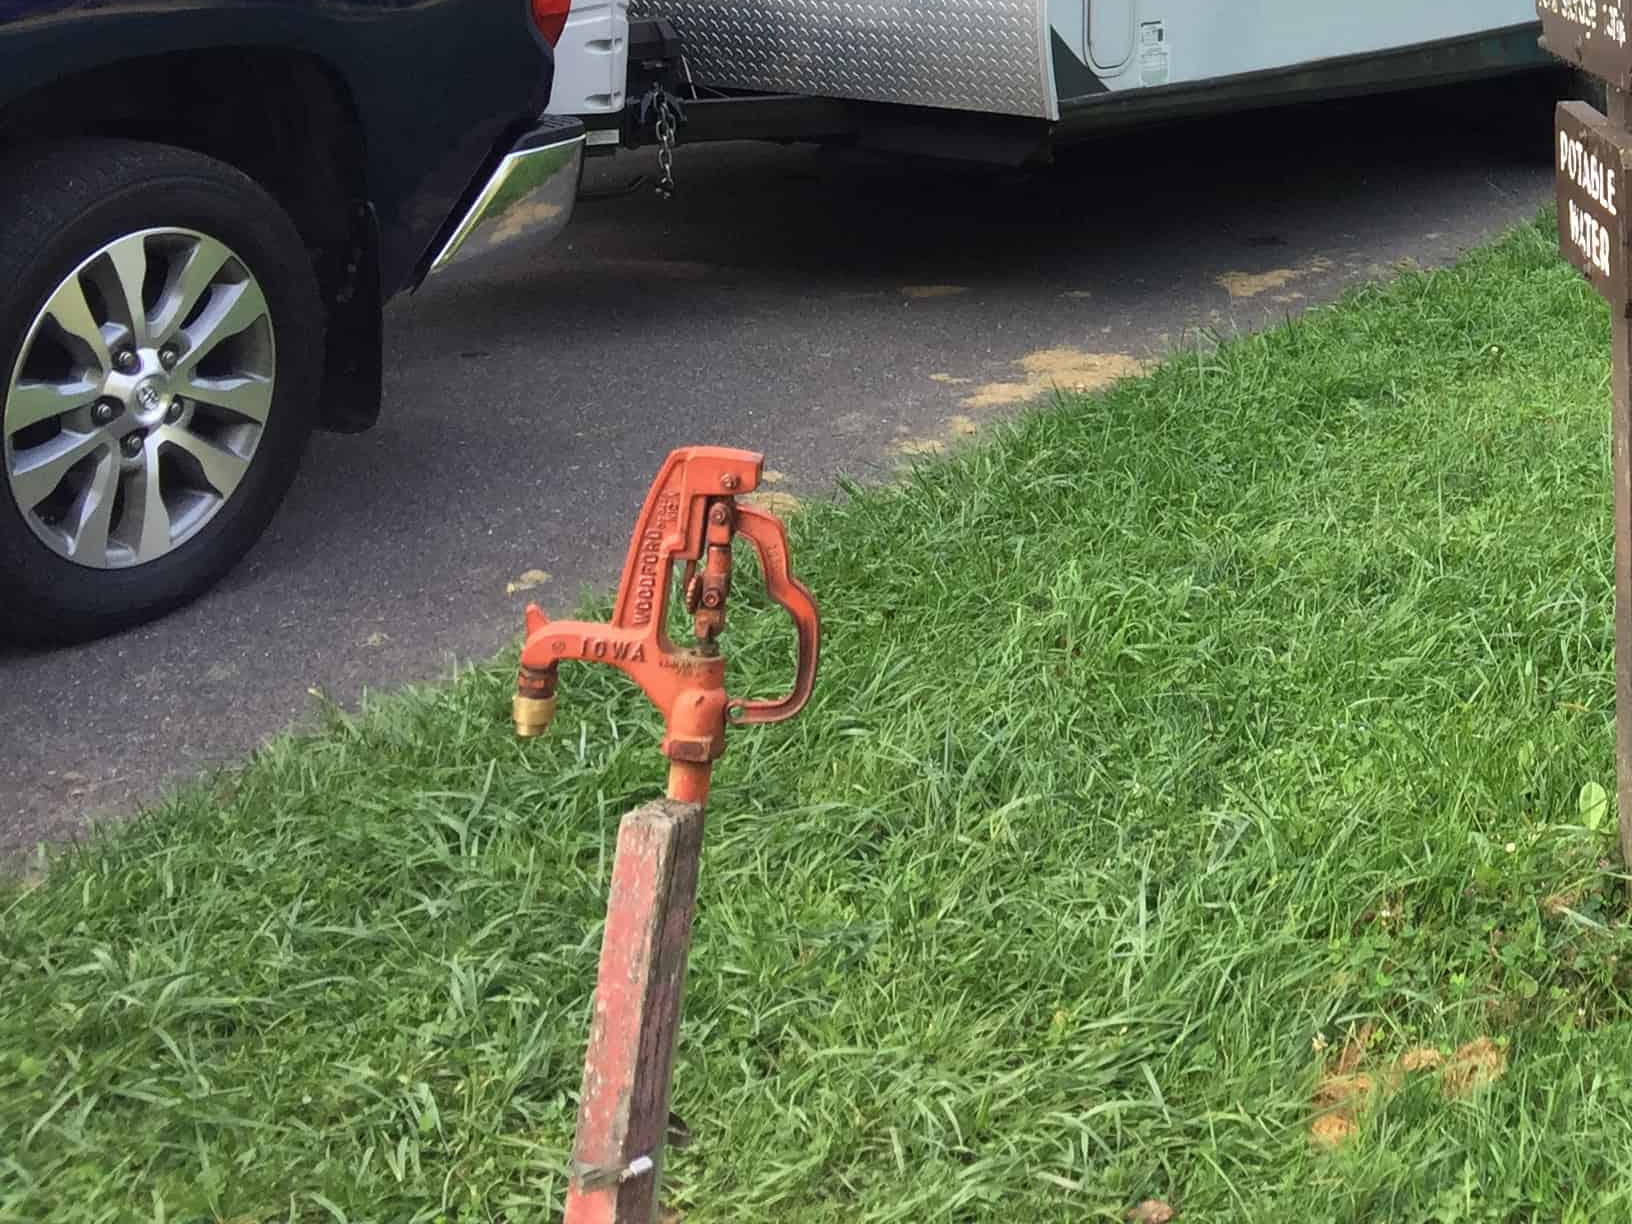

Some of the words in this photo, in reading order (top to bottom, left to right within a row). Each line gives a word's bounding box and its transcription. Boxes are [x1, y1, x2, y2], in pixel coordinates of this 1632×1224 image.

[1559, 129, 1617, 216] POTABLE
[1568, 198, 1611, 278] WATER
[633, 528, 662, 625] WOODFORD
[580, 638, 648, 664] IOWA
